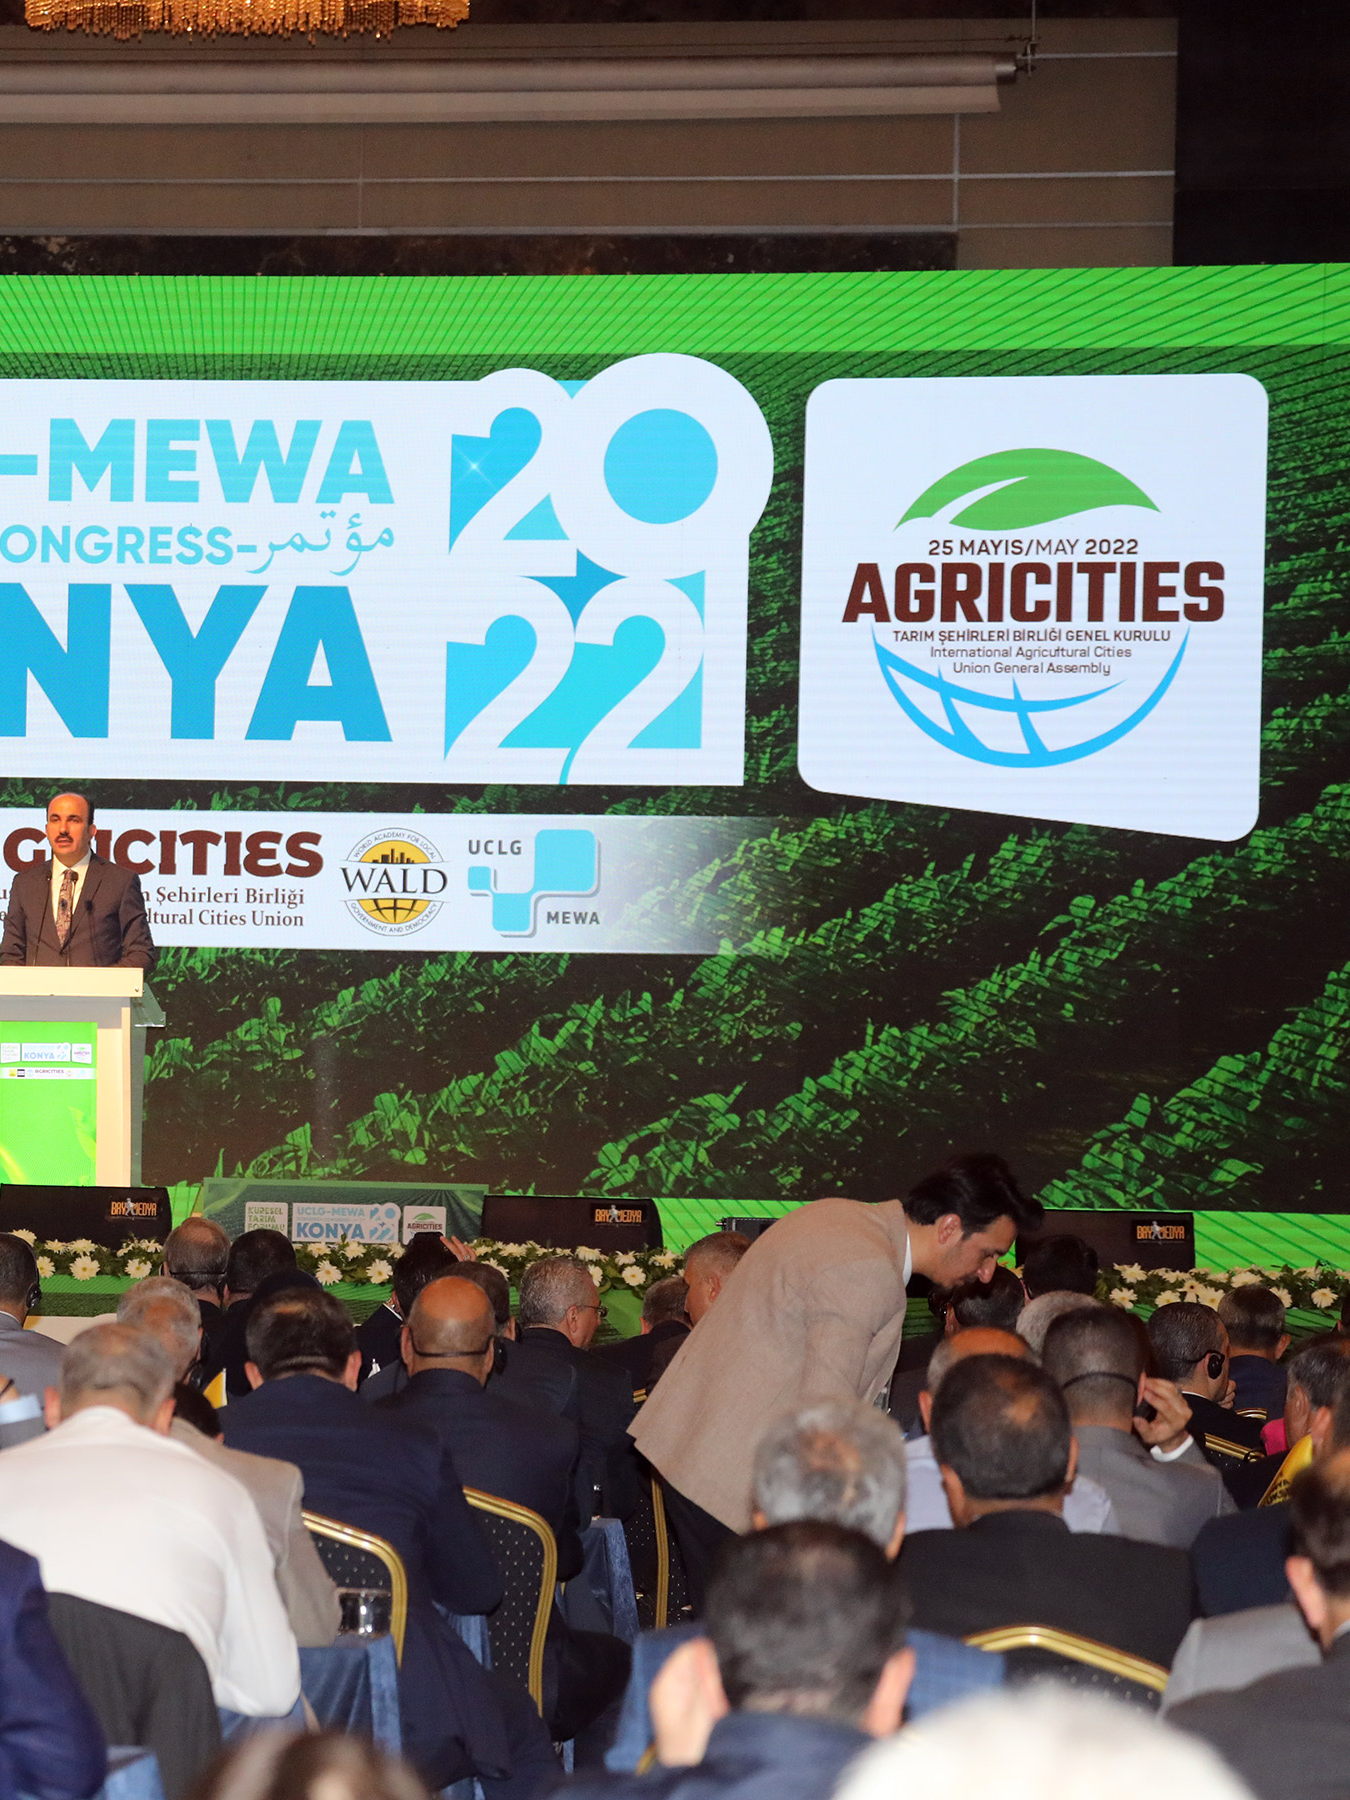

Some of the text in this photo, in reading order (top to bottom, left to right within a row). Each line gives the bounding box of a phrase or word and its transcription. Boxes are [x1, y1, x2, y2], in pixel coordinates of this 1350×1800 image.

[928, 538, 1139, 556] 25 MAYIS/MAY 2022
[841, 561, 1225, 623] AGRICITIES
[893, 630, 935, 642] TARIM
[1066, 630, 1111, 642] GENEL
[1114, 630, 1171, 642] KURULU
[930, 646, 1132, 661] International Agricultural Cities
[953, 661, 1111, 676] Union General Assembly
[354, 831, 436, 859] WORLD ACADEMY FOR LOCAL
[468, 839, 522, 855] UCLG
[339, 867, 448, 894] WALD
[156, 886, 239, 906] Şehirleri
[245, 887, 305, 909] Birliği
[198, 909, 247, 926] Cities
[251, 910, 304, 927] Union
[546, 911, 600, 925] MEWA
[24, 1052, 55, 1060] KONYA
[297, 1206, 365, 1217] UCLG-MEWA
[296, 1222, 365, 1239] KONYA
[407, 1222, 443, 1230] AGRICITIES
